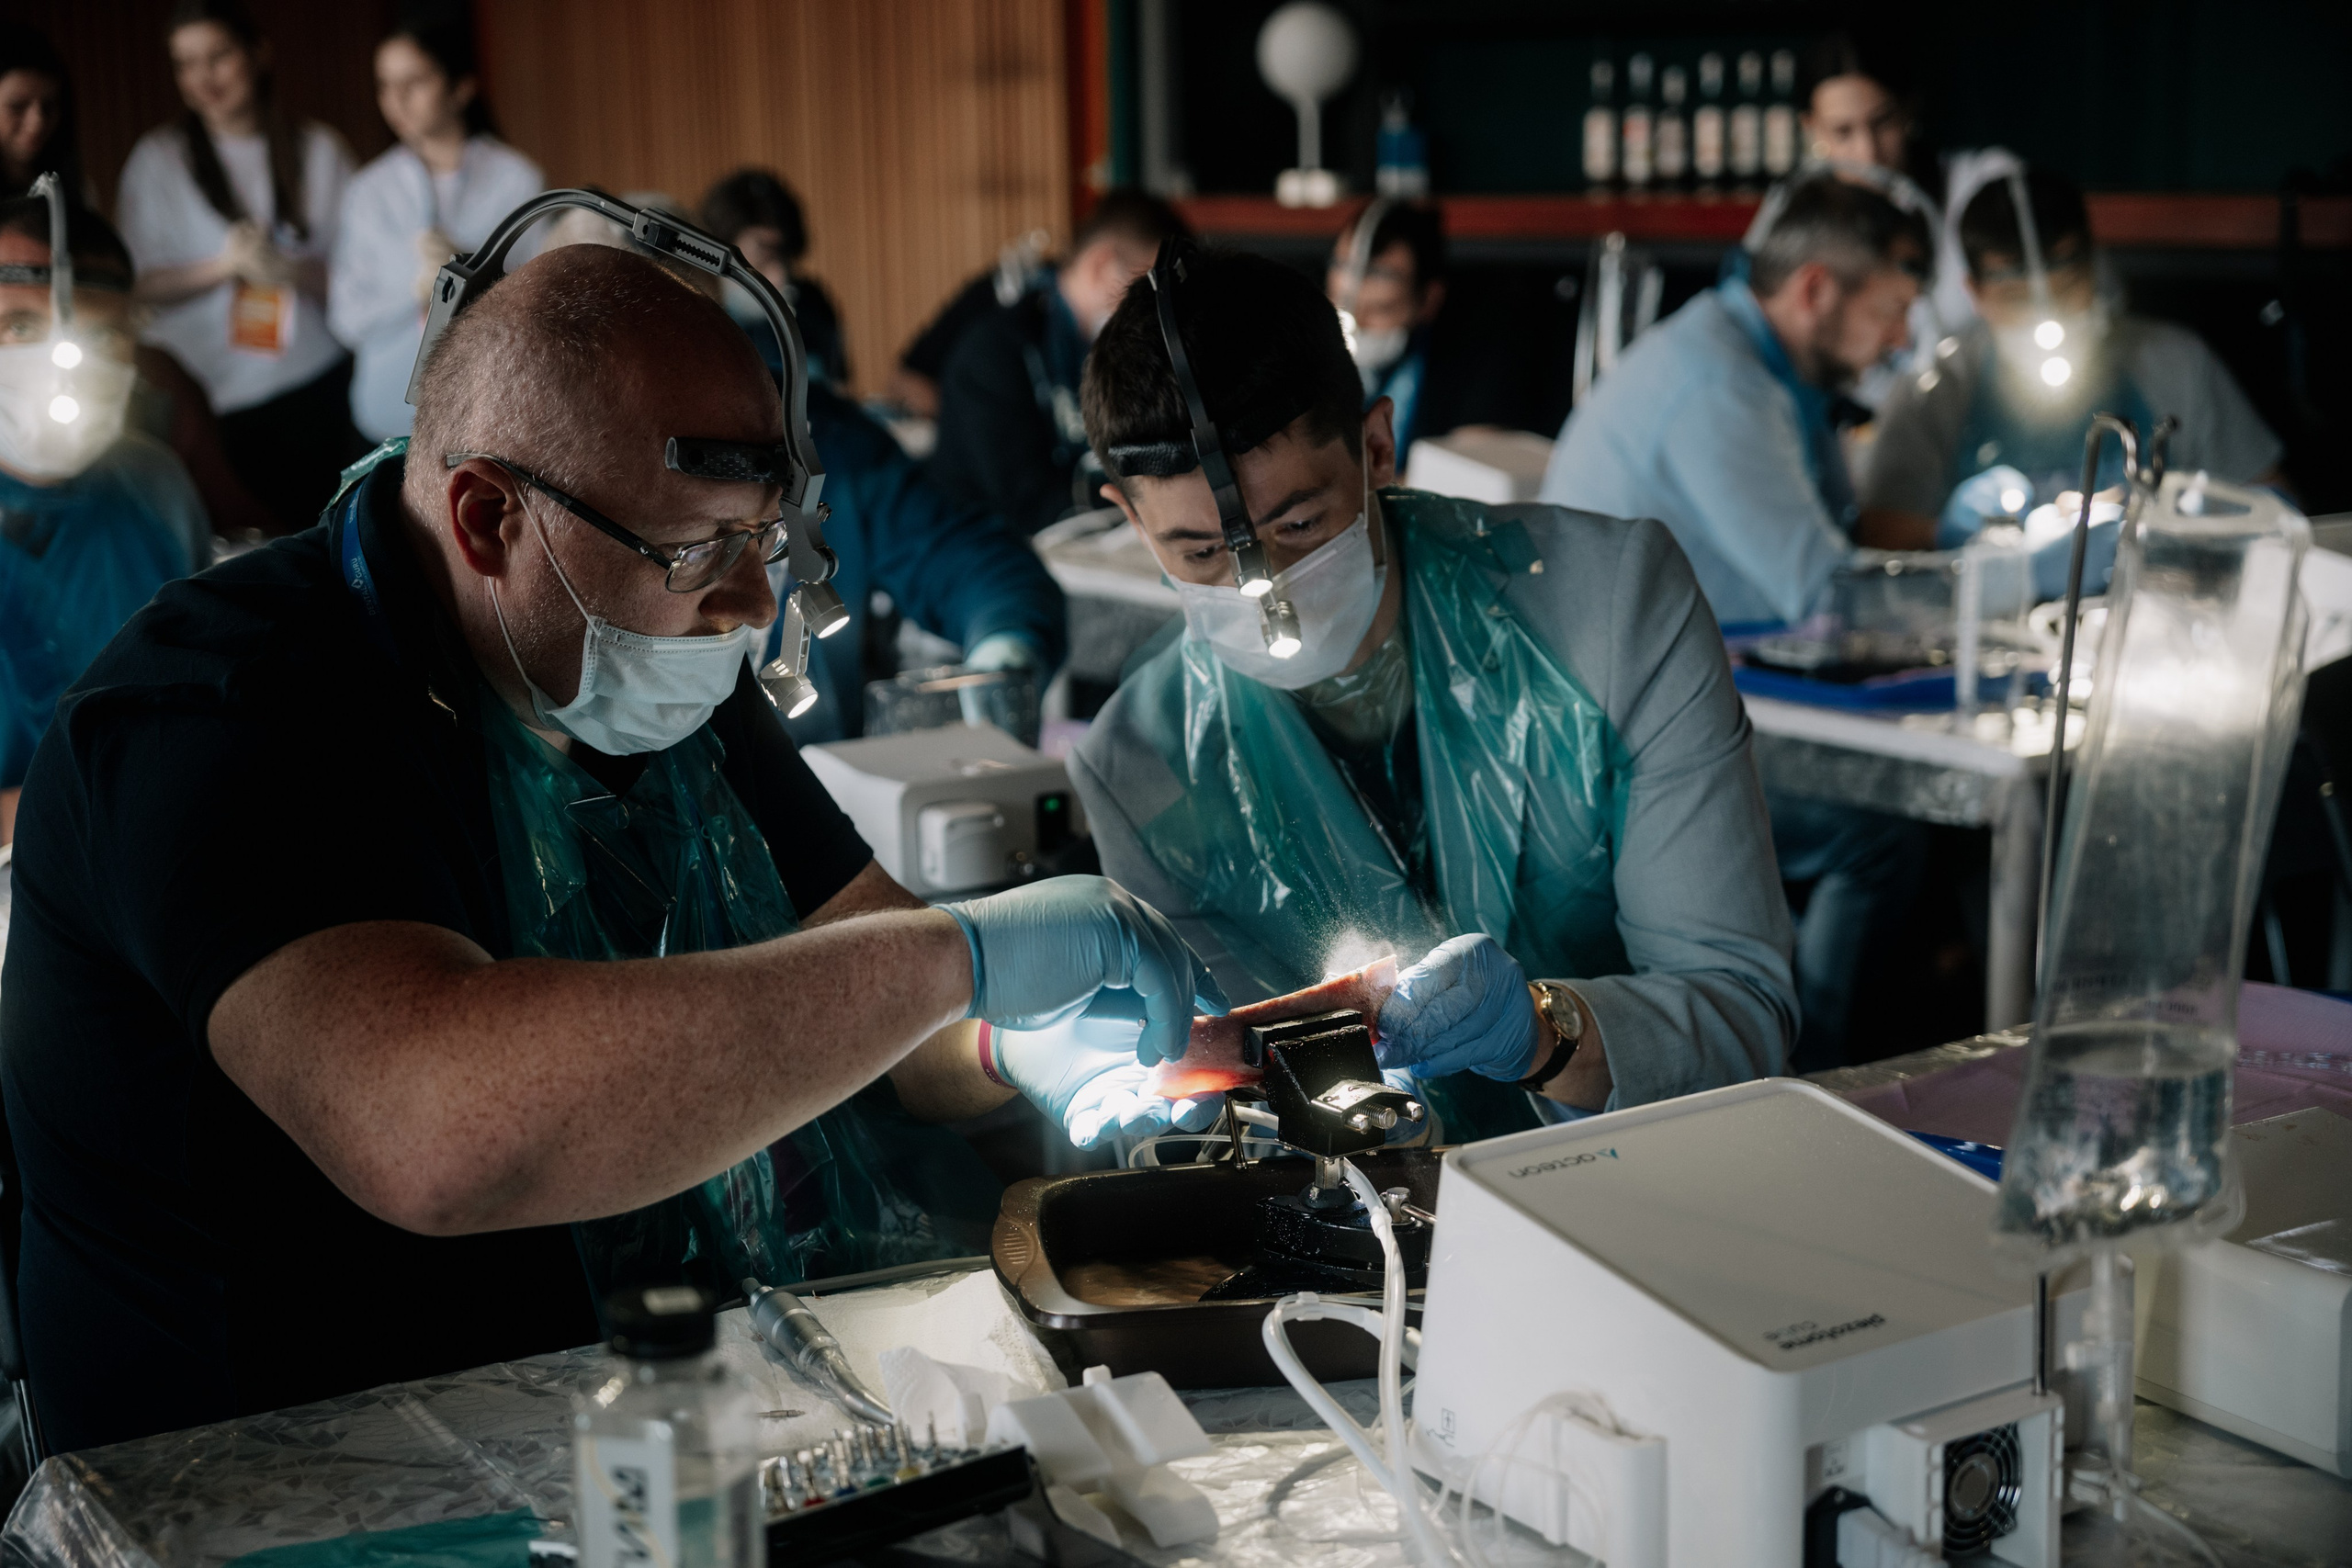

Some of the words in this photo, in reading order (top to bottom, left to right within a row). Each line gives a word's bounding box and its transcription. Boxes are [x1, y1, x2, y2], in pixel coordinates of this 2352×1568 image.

[351, 558, 363, 579] GURU
[360, 586, 376, 615] DENTAL
[1508, 1153, 1596, 1180] acteon
